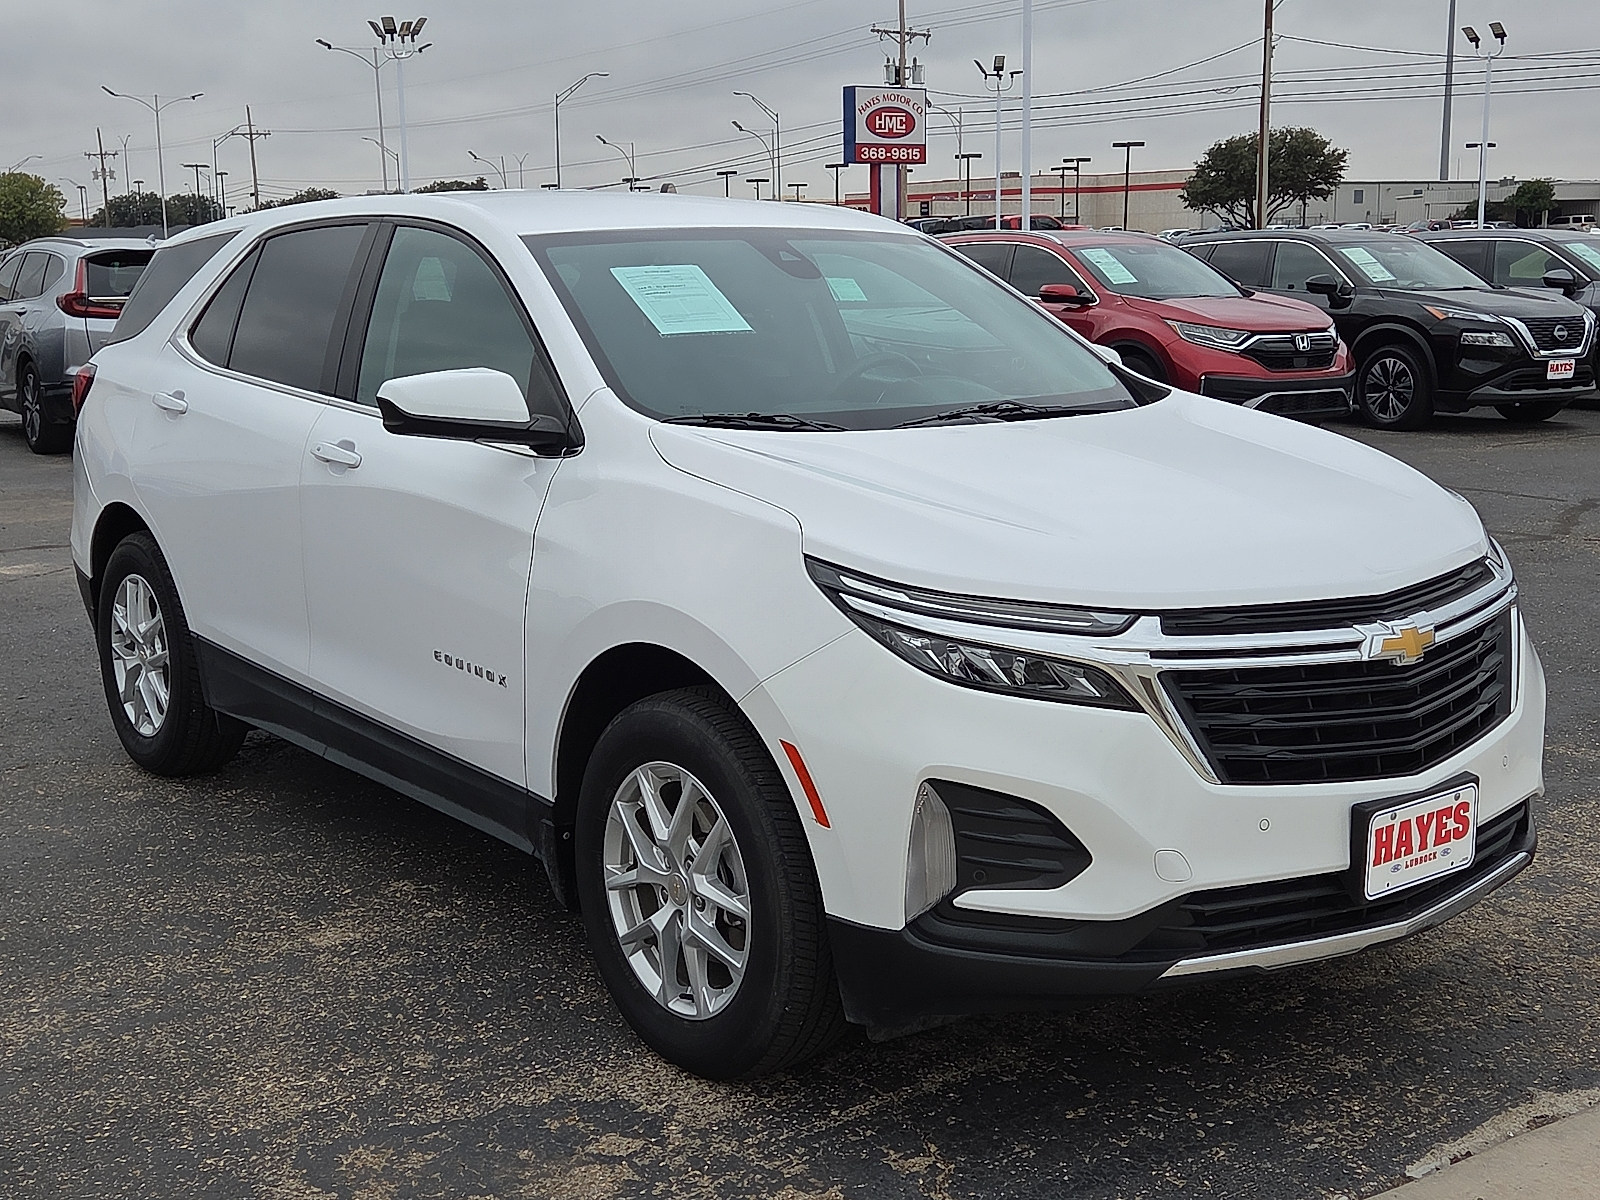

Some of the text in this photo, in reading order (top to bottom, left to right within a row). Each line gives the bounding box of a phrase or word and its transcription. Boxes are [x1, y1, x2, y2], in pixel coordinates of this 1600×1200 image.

[858, 93, 923, 117] HAYES MOTOR CO.
[876, 112, 906, 133] HMC
[861, 147, 920, 160] 368-9815
[1549, 362, 1573, 373] HAYES
[433, 650, 507, 688] EQUINOX
[1372, 801, 1470, 867] HAYES
[1404, 851, 1438, 870] LUBBOCK
